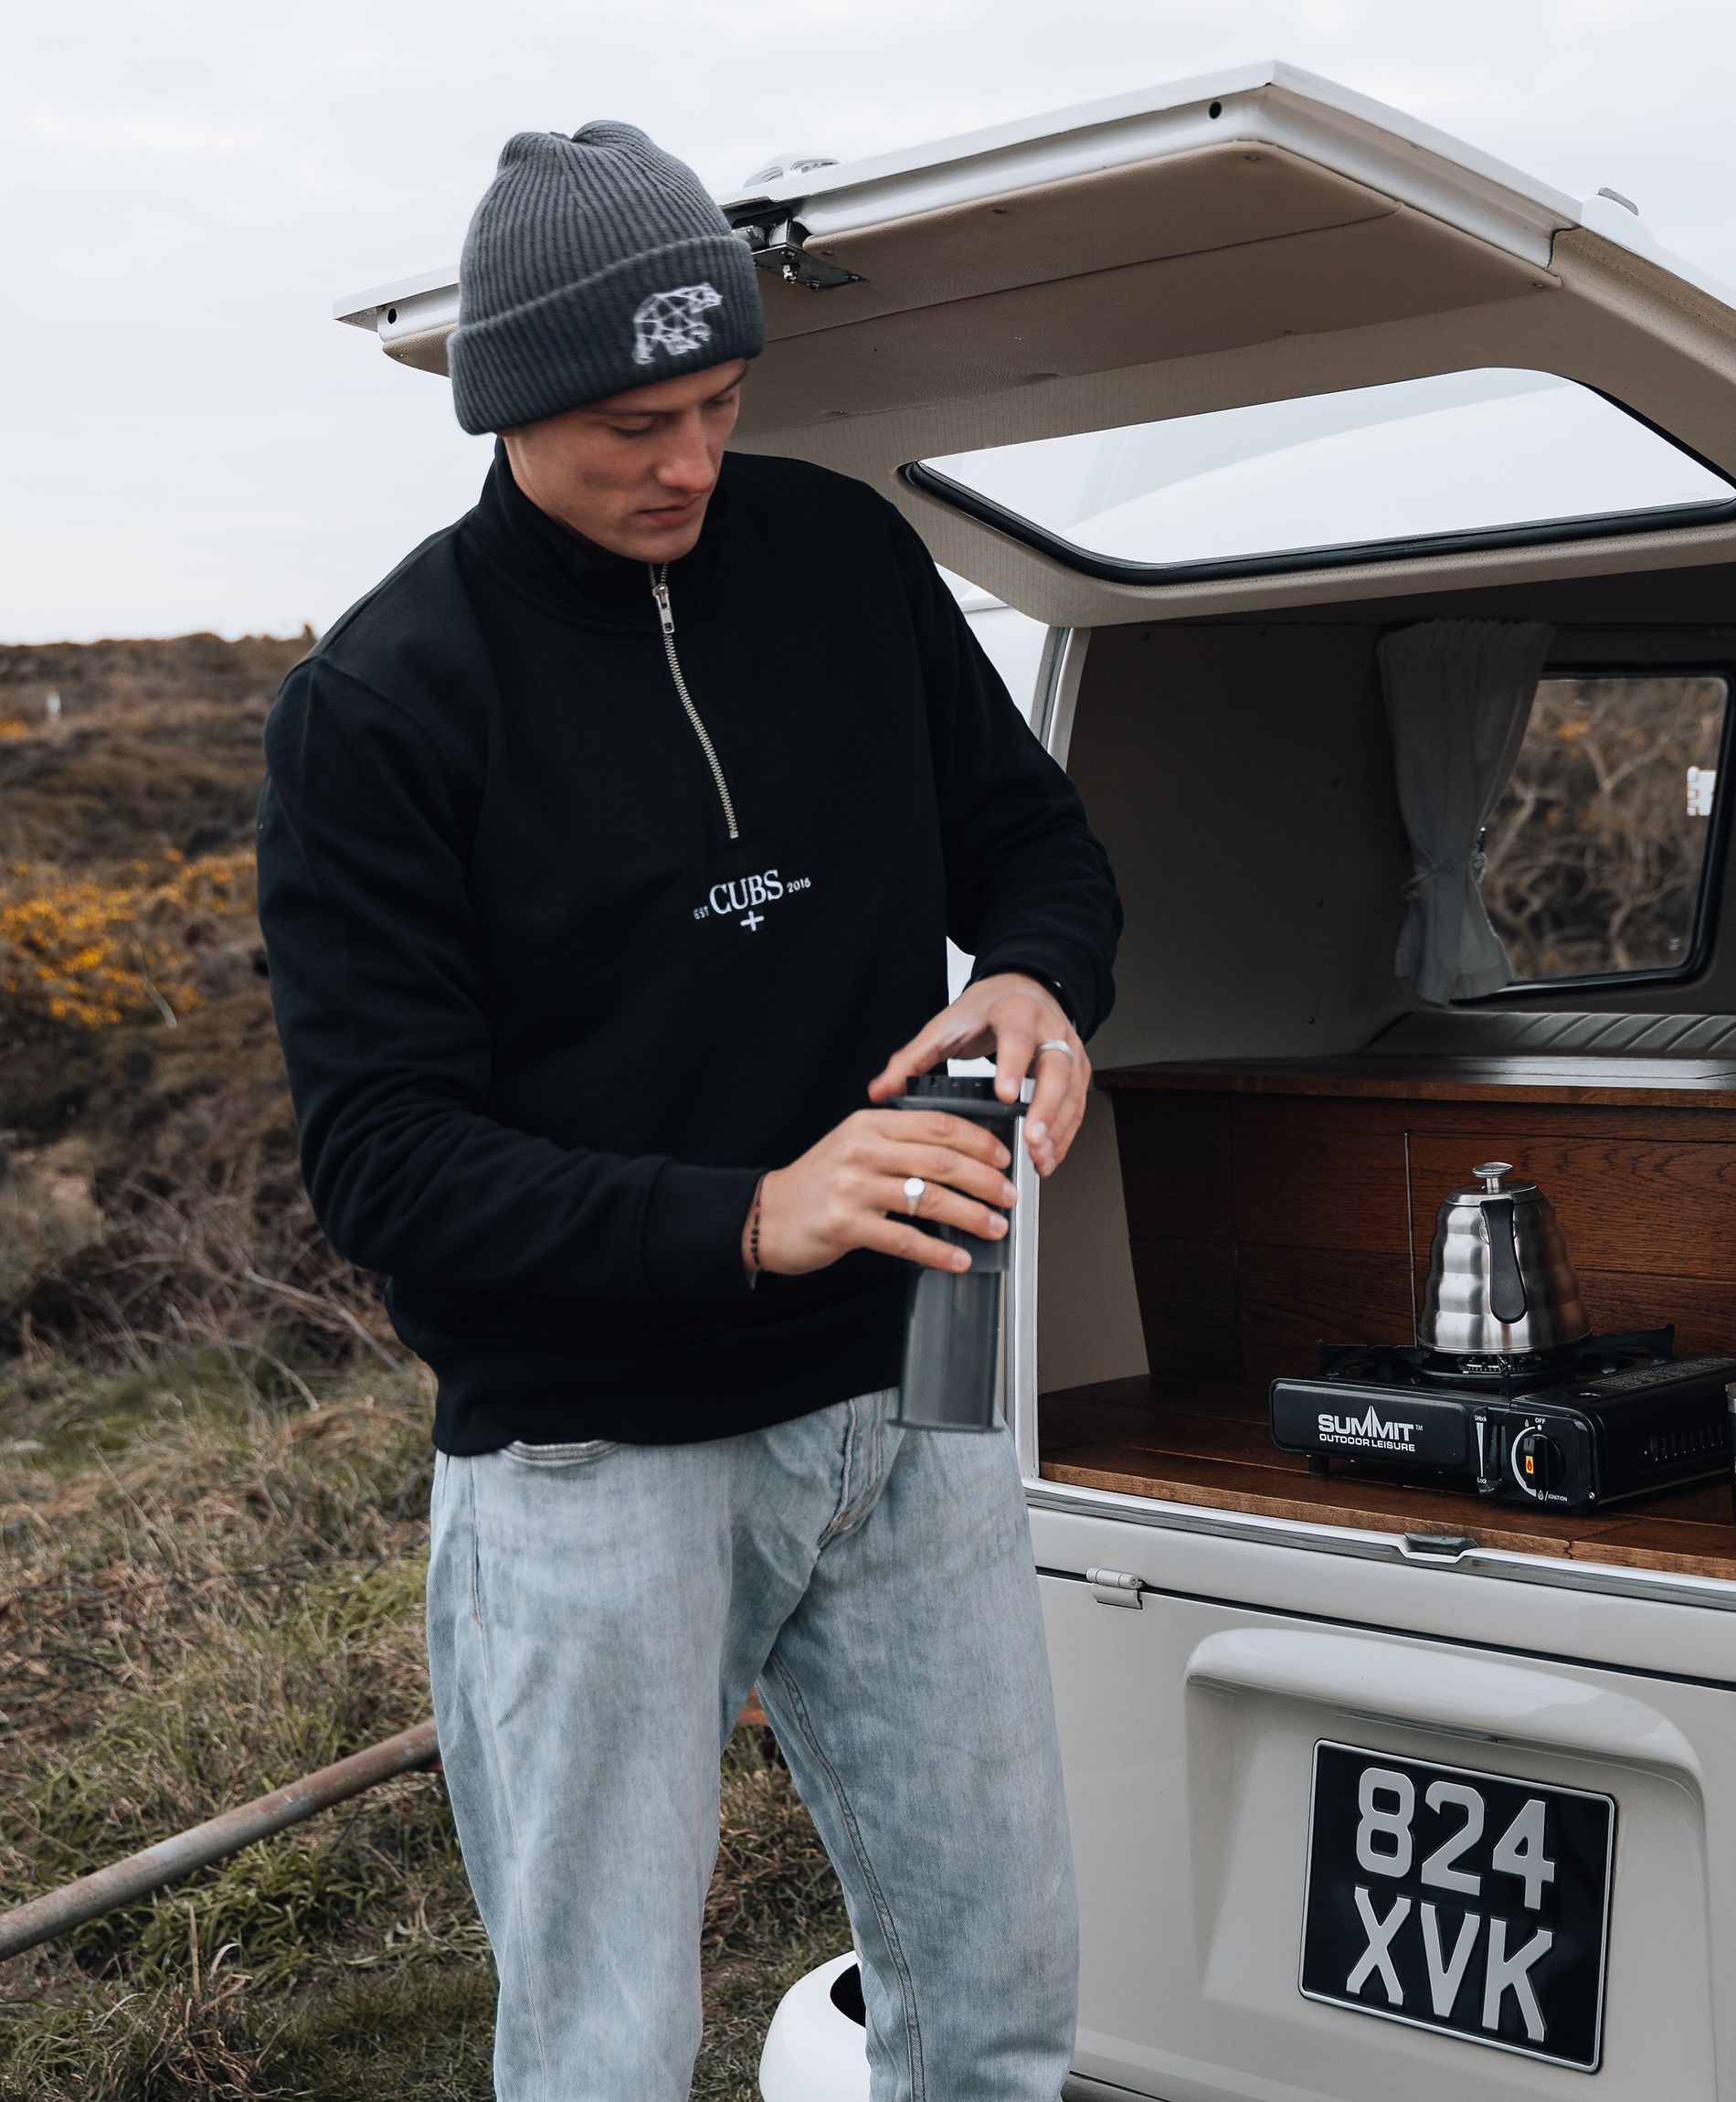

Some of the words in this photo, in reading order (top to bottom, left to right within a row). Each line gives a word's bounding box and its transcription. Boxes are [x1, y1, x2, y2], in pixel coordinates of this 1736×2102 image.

[693, 906, 709, 919] EST
[709, 869, 784, 915] CUBS
[787, 876, 811, 893] 2016
[1318, 1405, 1414, 1441] SUMMIT
[1319, 1433, 1371, 1447] OUTDOOR
[1371, 1439, 1416, 1452] LEISURE
[1477, 1476, 1487, 1484] Lock
[1356, 1767, 1555, 1911] 824
[1346, 1885, 1553, 2043] XVK
